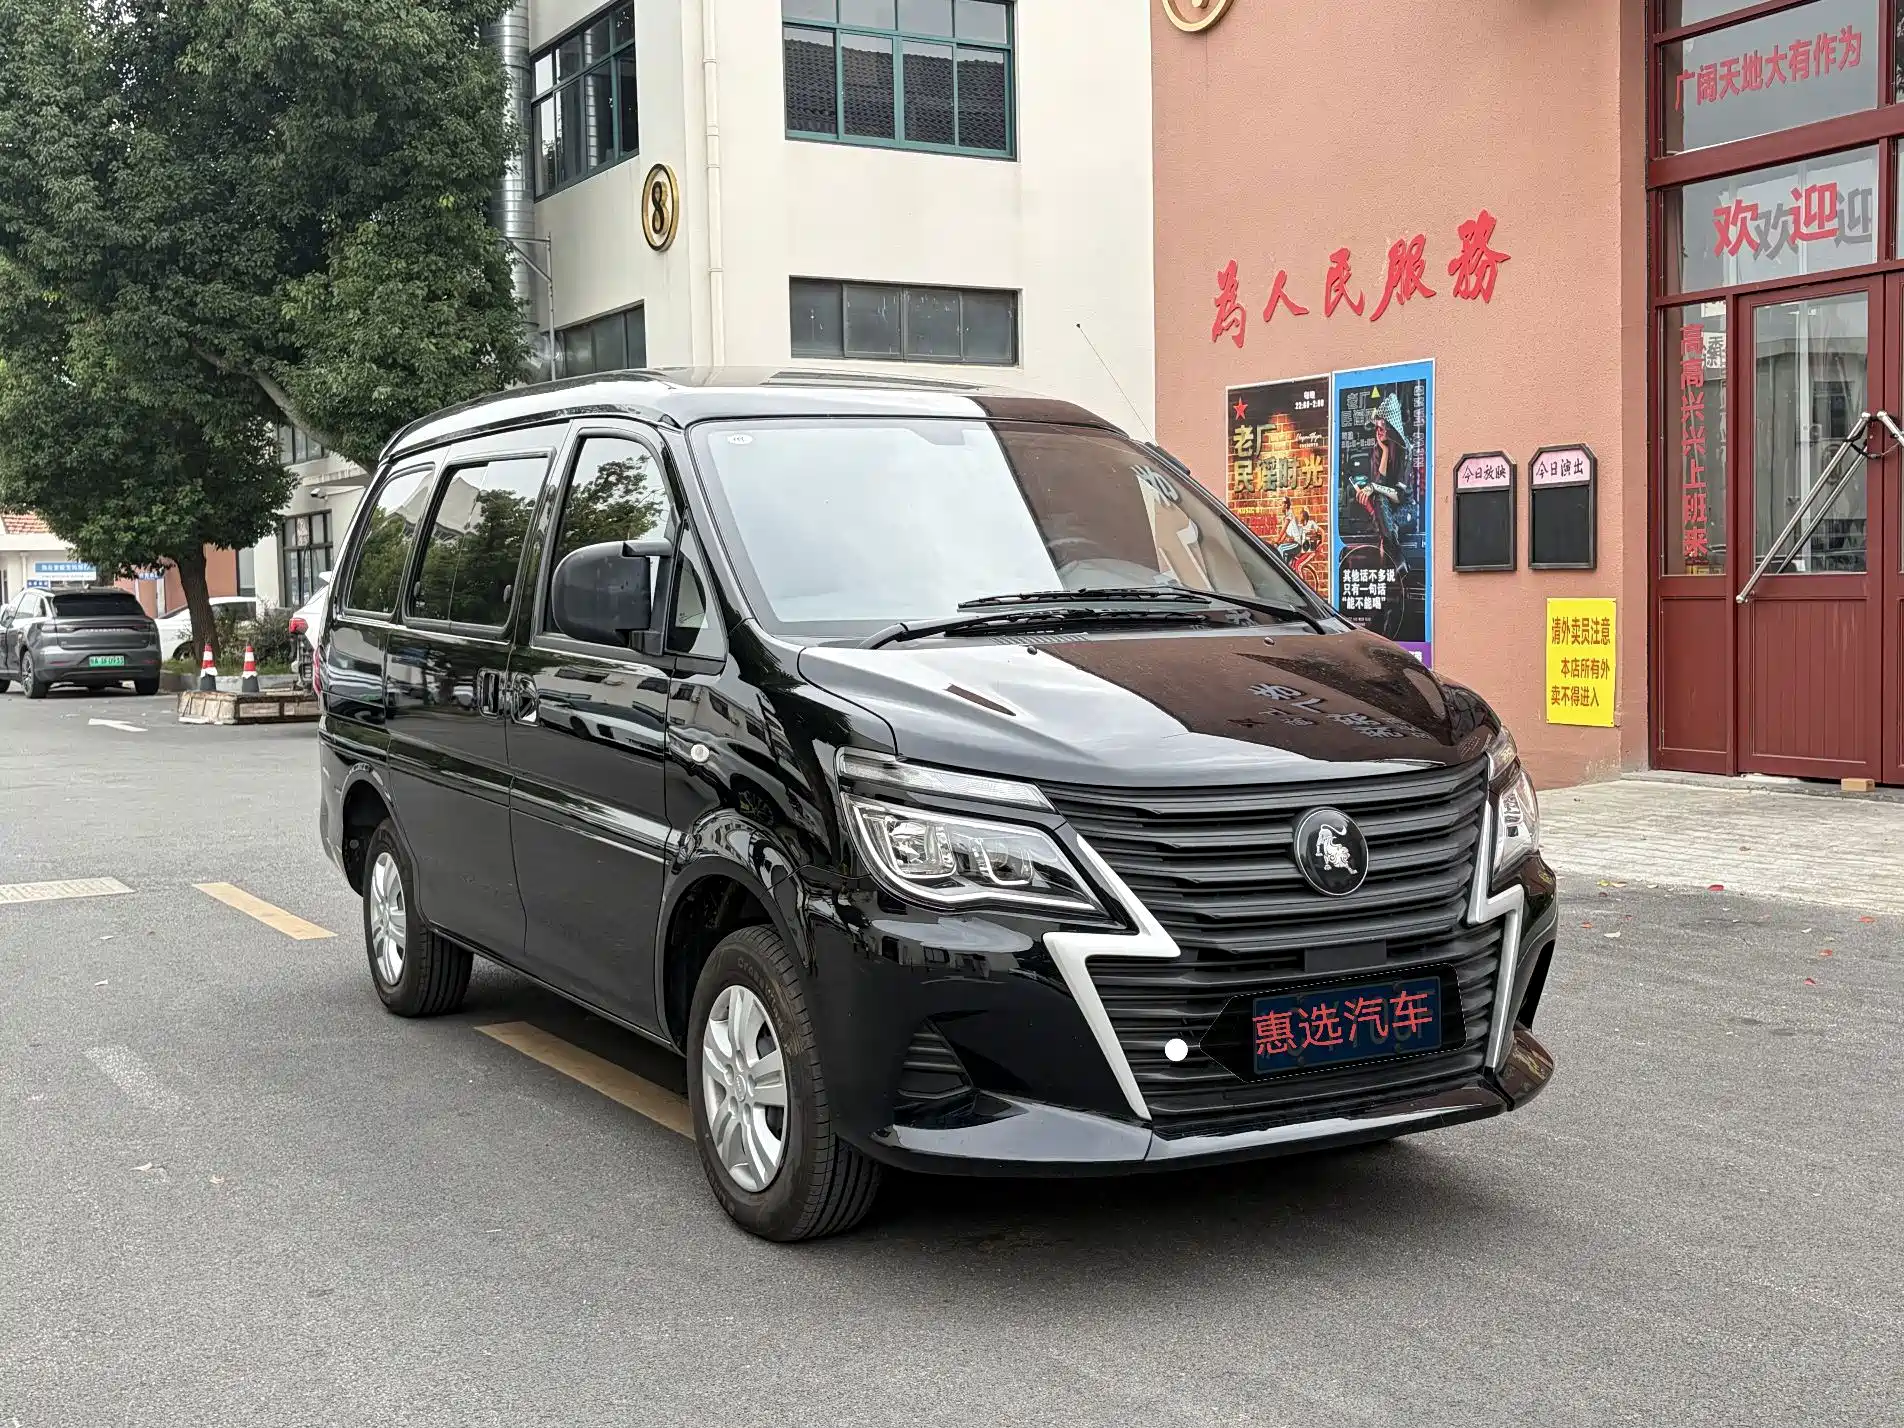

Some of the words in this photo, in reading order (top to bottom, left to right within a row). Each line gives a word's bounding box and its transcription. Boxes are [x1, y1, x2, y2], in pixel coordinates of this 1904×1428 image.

[1675, 25, 1863, 112] 广阔天地大有作为
[651, 181, 669, 235] 8
[1712, 182, 1840, 258] 欢迎
[1233, 425, 1277, 458] 老厂
[1680, 323, 1708, 557] 高高兴兴上班来
[1233, 454, 1324, 493] 民谣时光
[1462, 464, 1507, 482] 今日放映
[1536, 458, 1584, 479] 今日演出
[1342, 569, 1396, 583] 其他话不多说
[1342, 583, 1387, 596] 只有一句话
[1551, 616, 1611, 646] 请外卖员注意
[1560, 657, 1611, 680] 本店所有外
[1551, 685, 1600, 707] 卖不得进入
